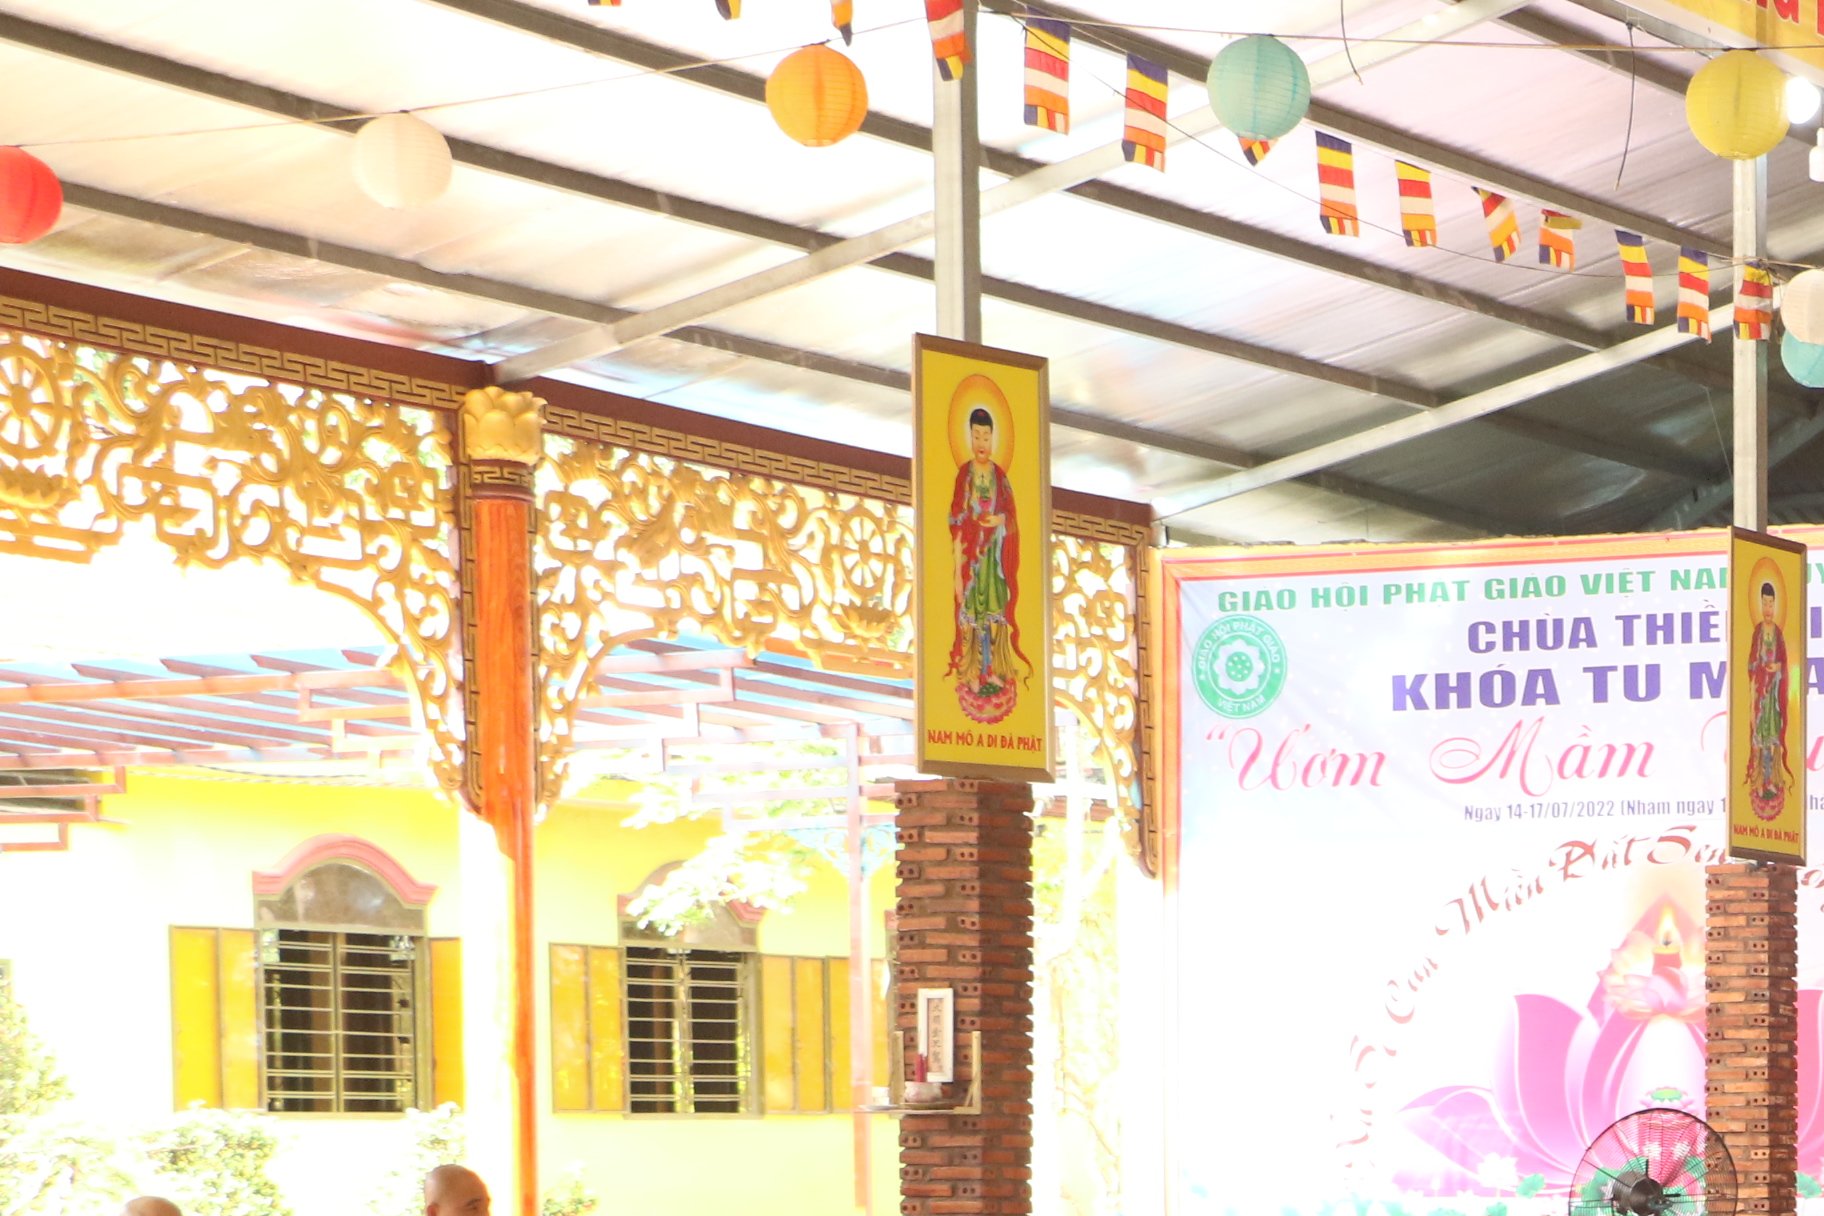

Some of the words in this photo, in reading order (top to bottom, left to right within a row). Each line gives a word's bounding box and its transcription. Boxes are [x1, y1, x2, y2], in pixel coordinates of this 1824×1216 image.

[1580, 568, 1656, 597] VIỆT
[1670, 567, 1728, 591] NA
[1468, 612, 1598, 654] CHÙA
[1615, 600, 1729, 647] THIỀ
[1391, 664, 1561, 712] KHÓA
[1583, 663, 1661, 704] TU
[928, 729, 952, 744] NAM
[956, 729, 974, 746] MÔ
[977, 736, 984, 748] A
[987, 736, 998, 748] DI
[1001, 733, 1014, 750] ĐÀ
[1017, 735, 1043, 754] PHẬT
[1429, 715, 1657, 798] Mầm
[1507, 800, 1615, 820] 14-17/07/2022
